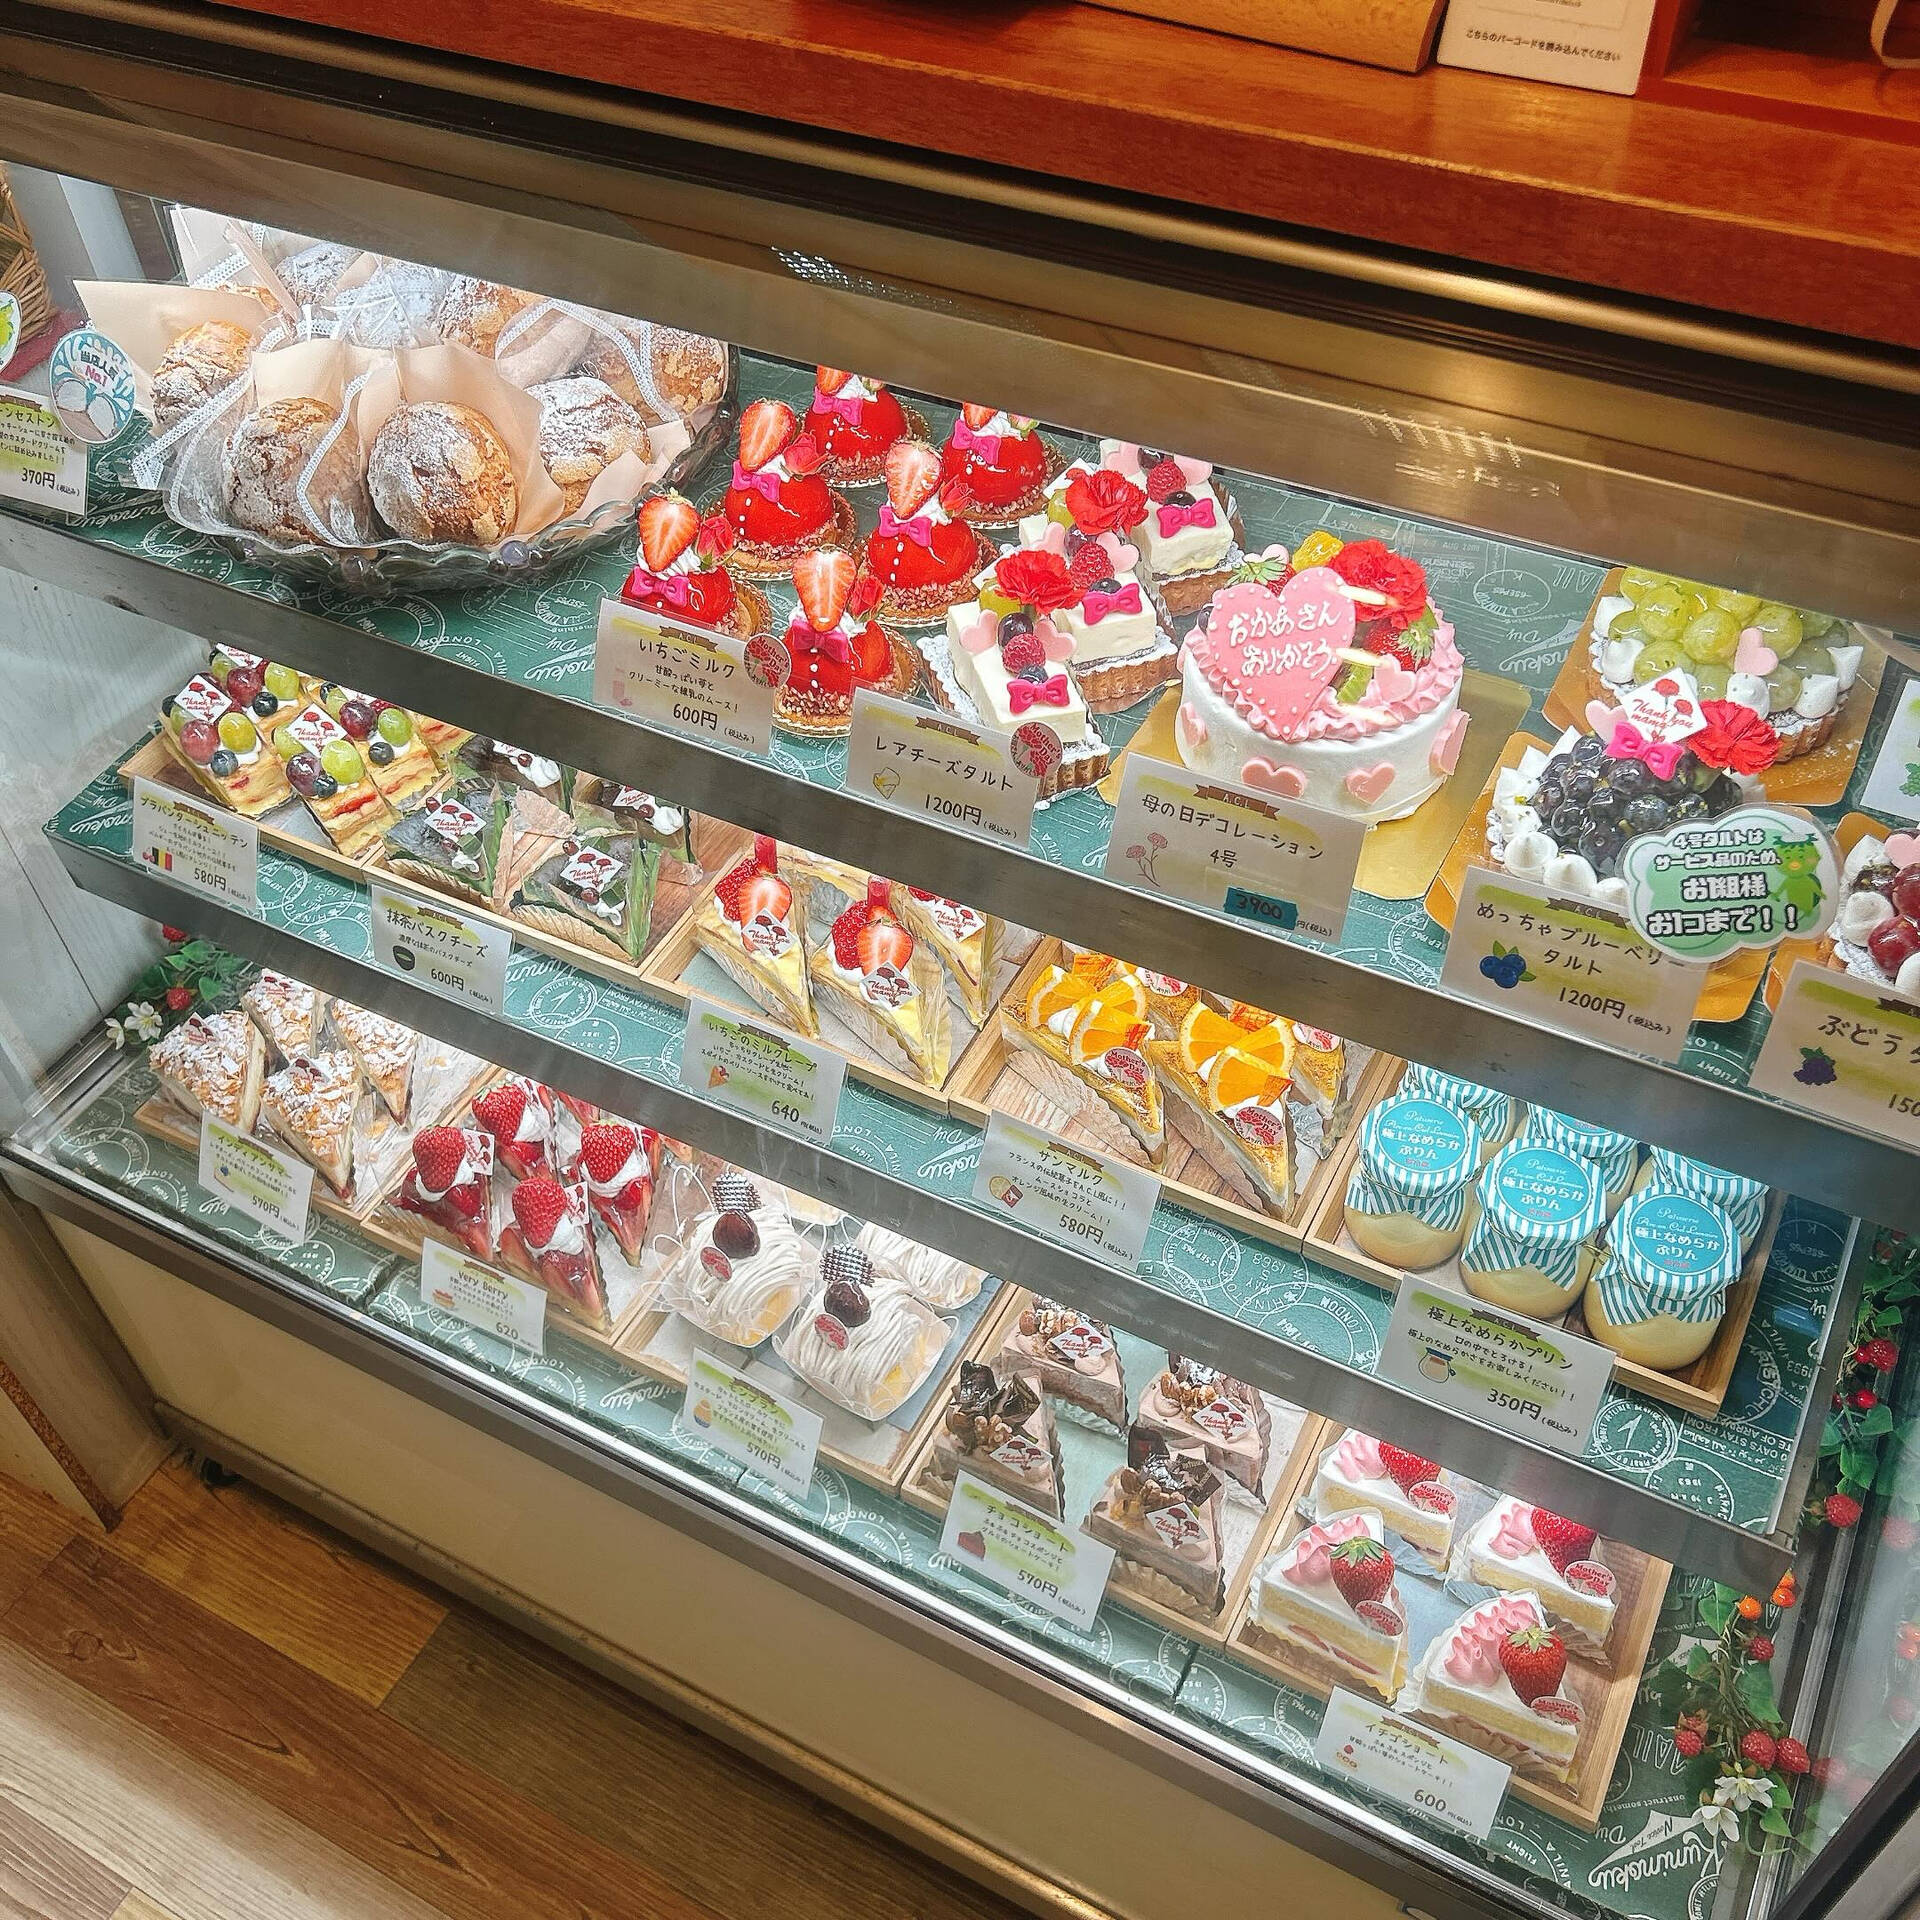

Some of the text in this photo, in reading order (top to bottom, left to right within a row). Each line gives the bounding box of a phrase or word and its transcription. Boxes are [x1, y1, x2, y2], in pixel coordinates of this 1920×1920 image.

[22, 467, 55, 490] 370円
[639, 638, 735, 679] いちごミルク
[673, 703, 718, 731] 600円
[876, 736, 1014, 791] レアチーズタルト
[925, 794, 982, 826] 1200円
[1142, 794, 1323, 860] 母の日デコレーション
[1673, 828, 1766, 850] 4号タルトは
[1210, 849, 1238, 868] 4号
[1653, 849, 1783, 872] サービス品のため、
[194, 867, 227, 891] 580円
[387, 908, 489, 958] 抹茶バスクチーズ
[1543, 947, 1603, 977] タルト
[431, 968, 464, 991] 600円
[1558, 986, 1626, 1020] 1200円
[708, 1022, 818, 1073] いちごのミルクレープ
[771, 1100, 800, 1123] 640
[1039, 1150, 1103, 1186] サンマルク
[1059, 1213, 1104, 1245] 580円
[458, 1270, 508, 1301] Very Berry
[495, 1321, 519, 1340] 620
[1427, 1305, 1574, 1371] 極上なめらかプリン
[1487, 1387, 1542, 1421] 350円
[747, 1442, 782, 1469] 570円
[986, 1504, 1069, 1552] チョコショート
[1017, 1569, 1059, 1599] 570円
[1366, 1723, 1448, 1765] イチゴショート
[1414, 1788, 1447, 1812] 600
